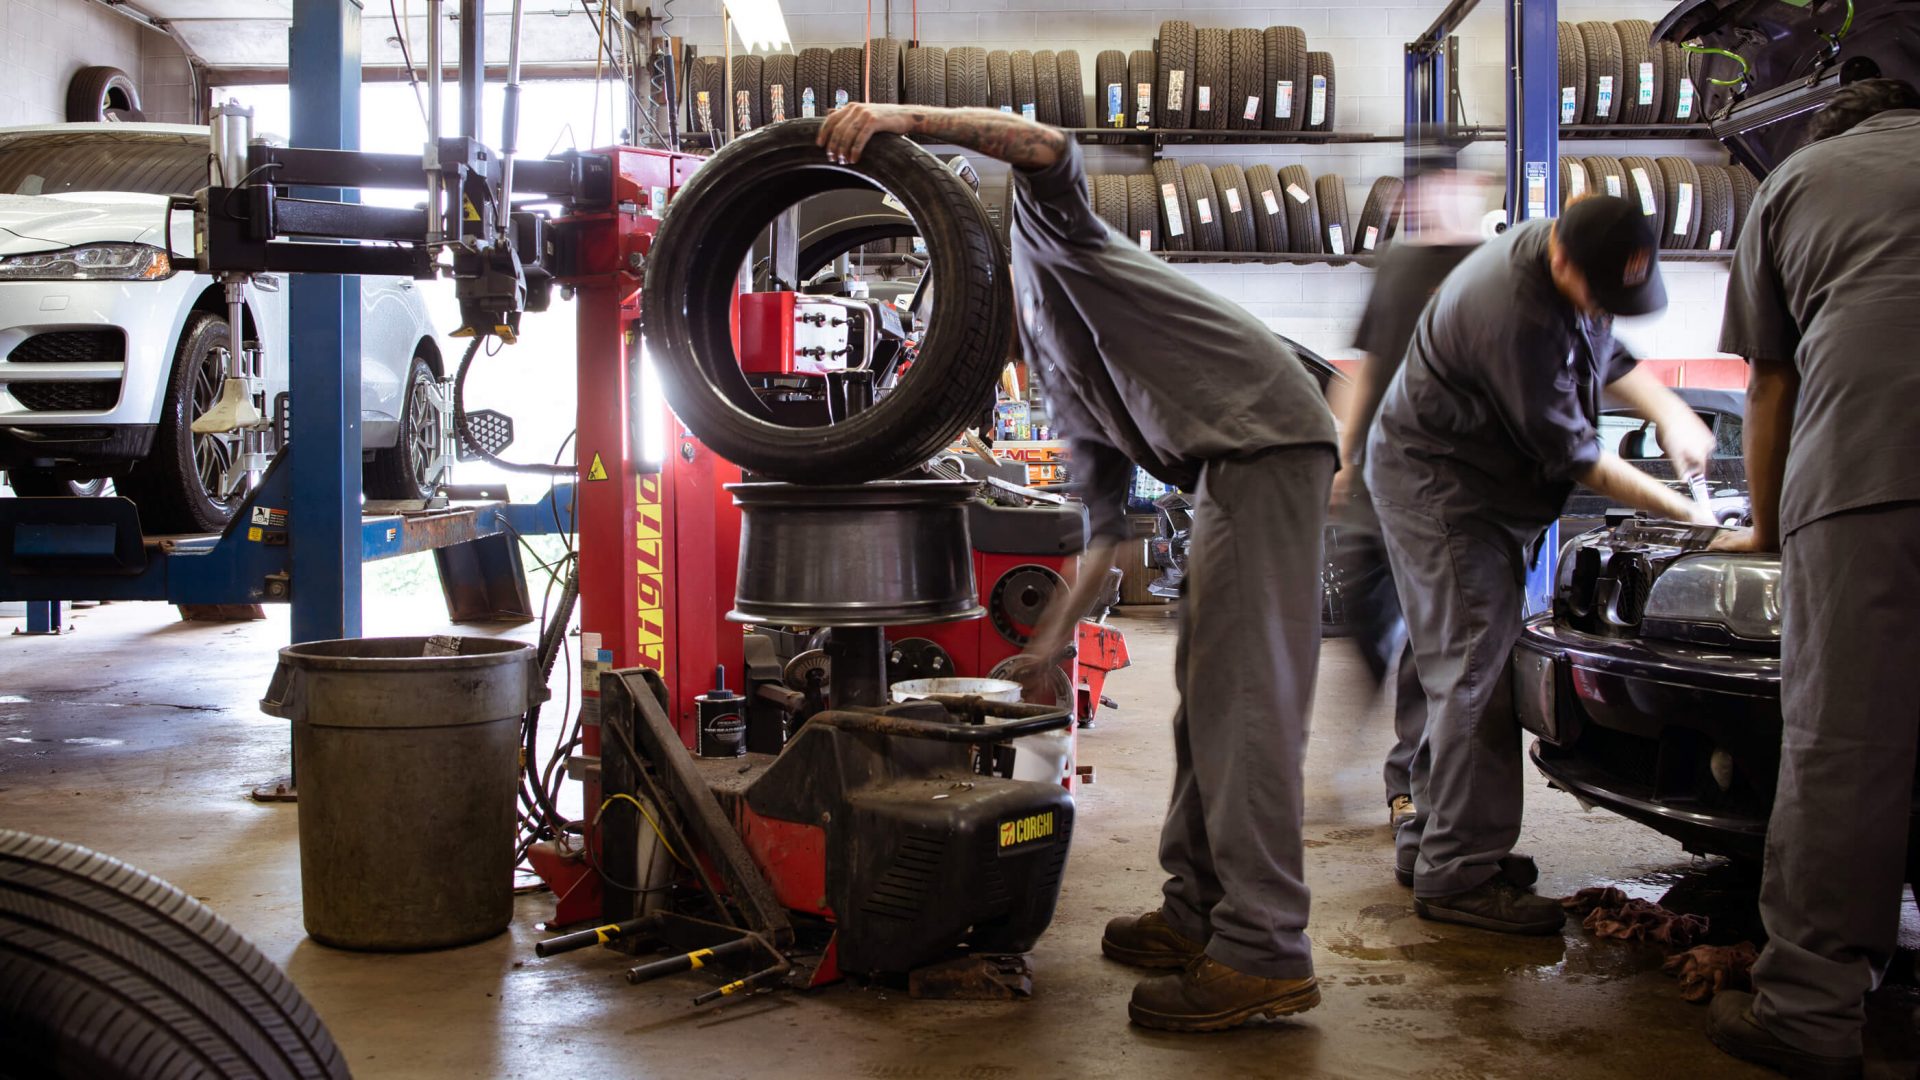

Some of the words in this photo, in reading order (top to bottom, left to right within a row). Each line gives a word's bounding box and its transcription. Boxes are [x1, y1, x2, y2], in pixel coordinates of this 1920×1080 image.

[1600, 91, 1611, 100] TR
[1563, 102, 1575, 110] TR
[1016, 811, 1053, 843] CORGHI
